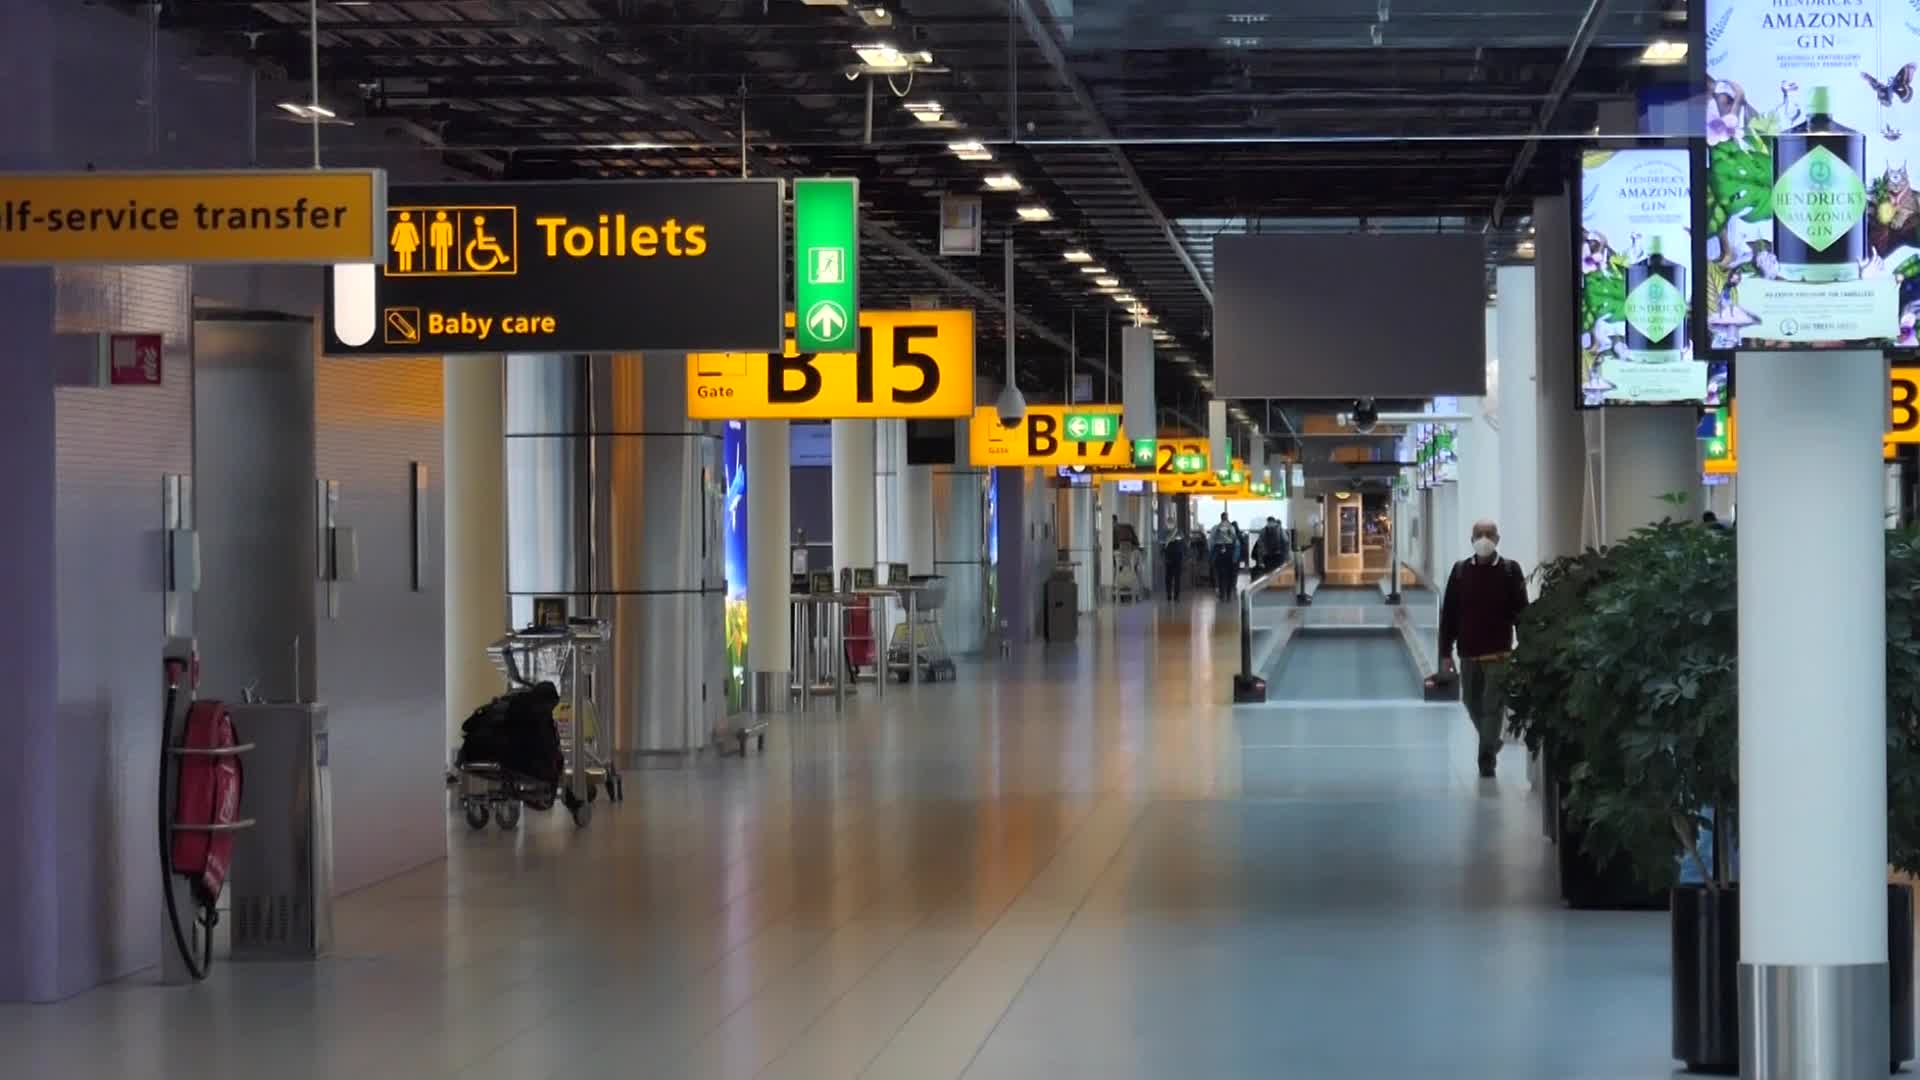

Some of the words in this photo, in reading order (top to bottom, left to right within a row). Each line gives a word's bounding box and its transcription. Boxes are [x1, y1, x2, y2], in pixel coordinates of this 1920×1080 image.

[1762, 12, 1874, 28] AMAZONIA
[1797, 34, 1834, 48] GIN
[1641, 201, 1666, 211] GIN
[194, 198, 347, 230] transfer
[536, 213, 707, 257] Toilets
[1807, 224, 1832, 236] GIN
[428, 313, 492, 340] Baby
[501, 317, 556, 334] care
[697, 386, 734, 399] Gate
